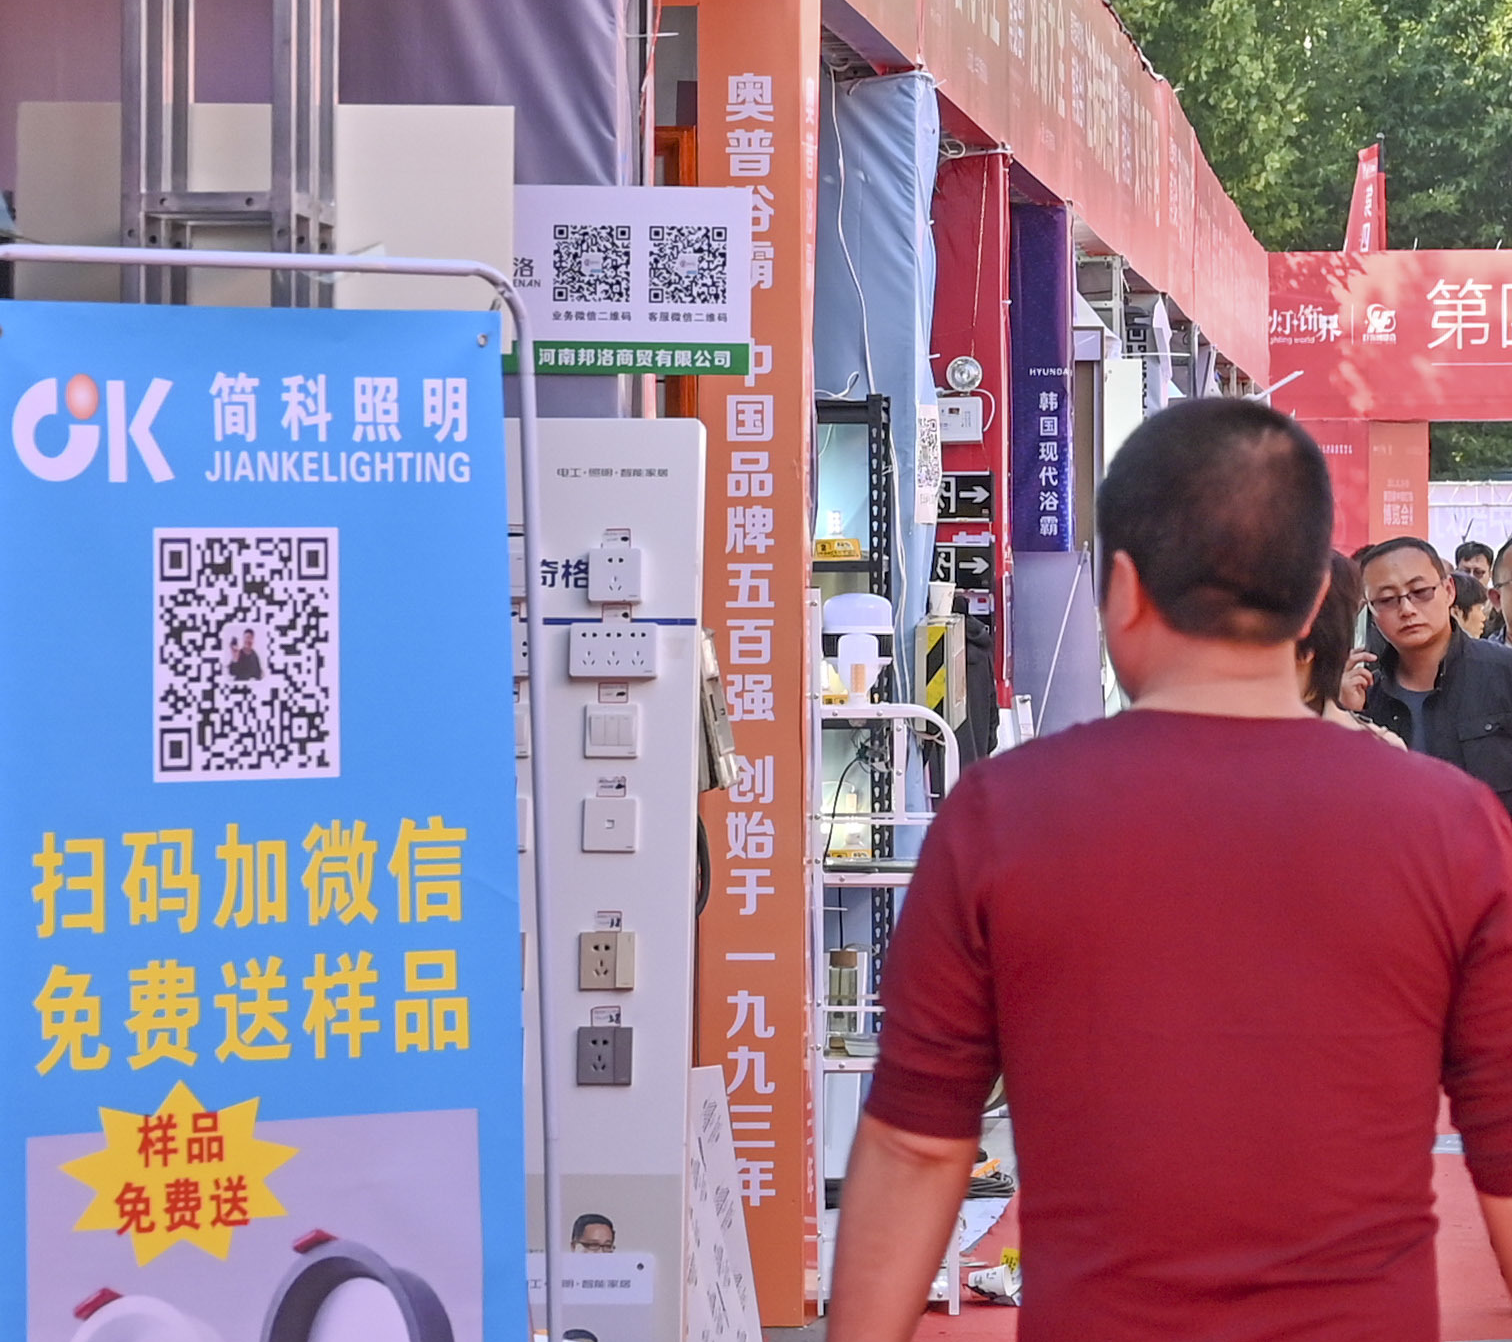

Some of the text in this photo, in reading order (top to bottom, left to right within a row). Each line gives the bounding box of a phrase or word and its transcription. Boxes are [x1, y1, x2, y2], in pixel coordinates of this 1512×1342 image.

[552, 311, 728, 323] 业务微信二维码 客服微信二维码
[538, 348, 732, 368] 河南邦洛商贸有限公司
[209, 372, 469, 443] 简科照明
[205, 451, 472, 484] JIANKELIGHTING
[1039, 392, 1059, 537] 韩国现代浴霸
[726, 755, 775, 917] 创始于
[31, 815, 467, 938] 扫码加微信
[33, 950, 470, 1076] 免费送样品
[137, 1111, 224, 1167] 样品
[115, 1175, 251, 1235] 免费送
